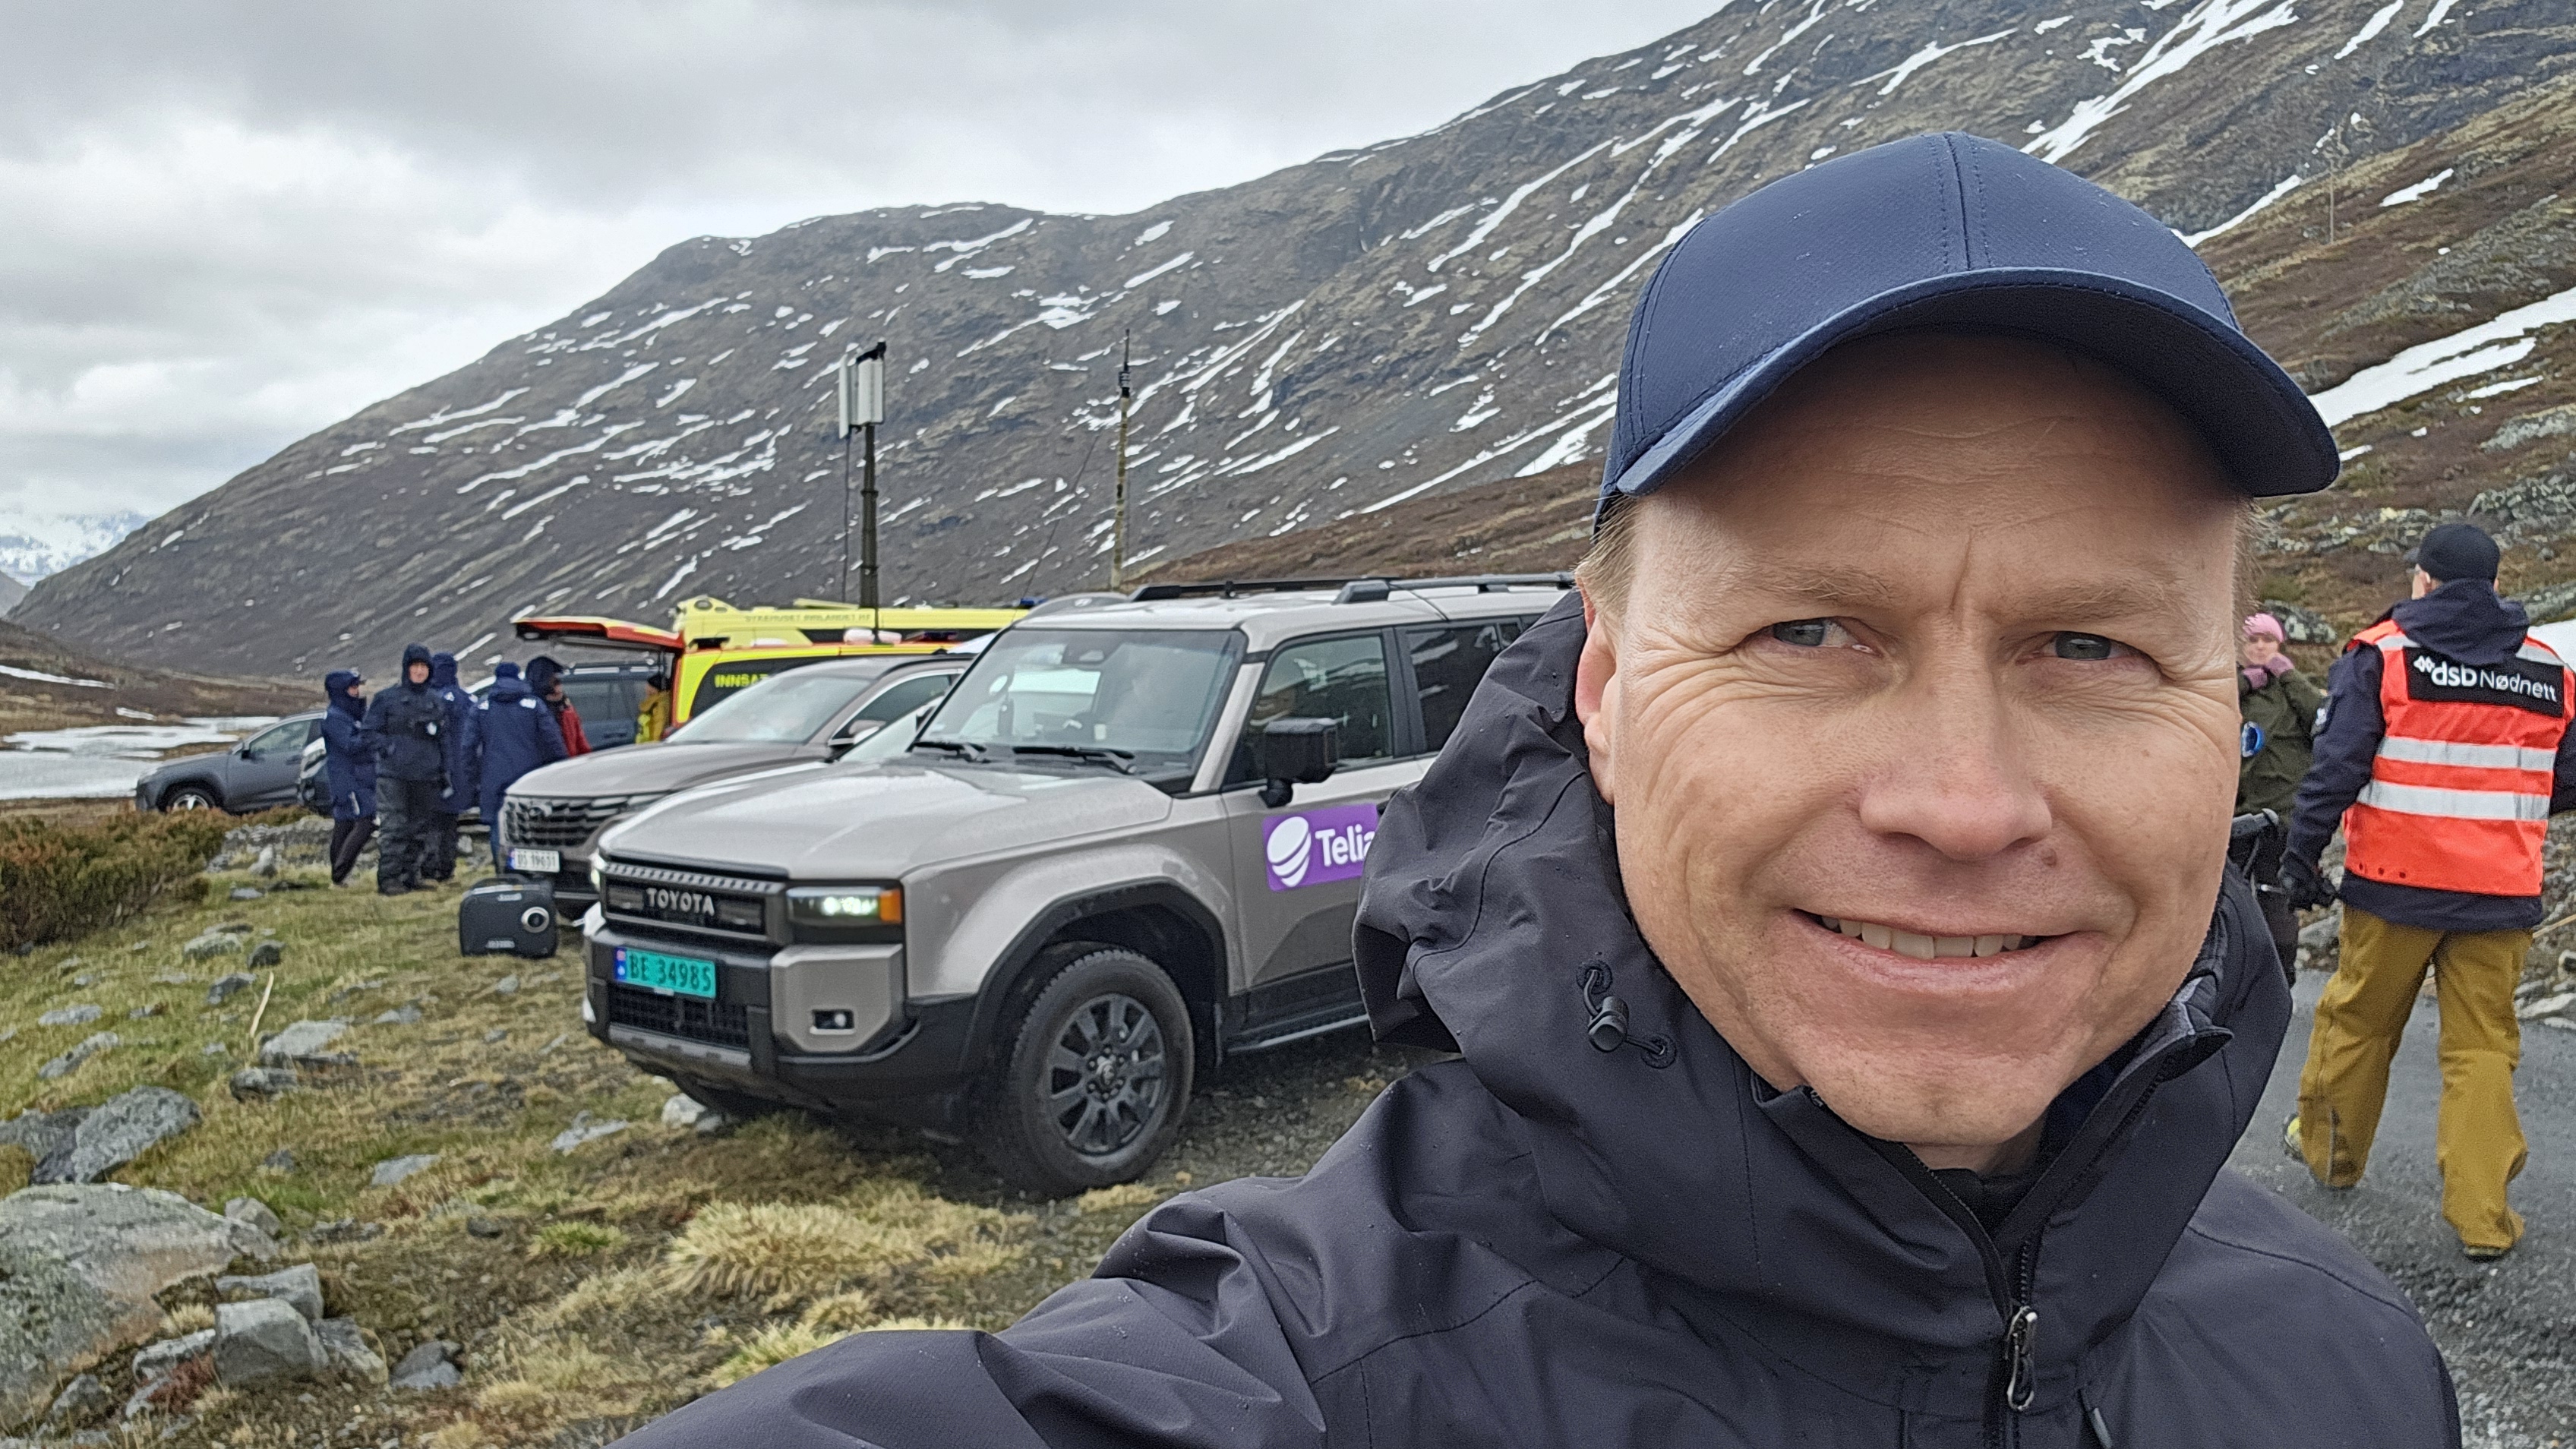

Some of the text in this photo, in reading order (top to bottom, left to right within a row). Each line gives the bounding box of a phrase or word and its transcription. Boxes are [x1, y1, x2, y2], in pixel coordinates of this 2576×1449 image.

[2431, 661, 2557, 702] dsb Nødnett
[646, 887, 715, 916] TOYOTA
[630, 954, 712, 992] BE 34985
